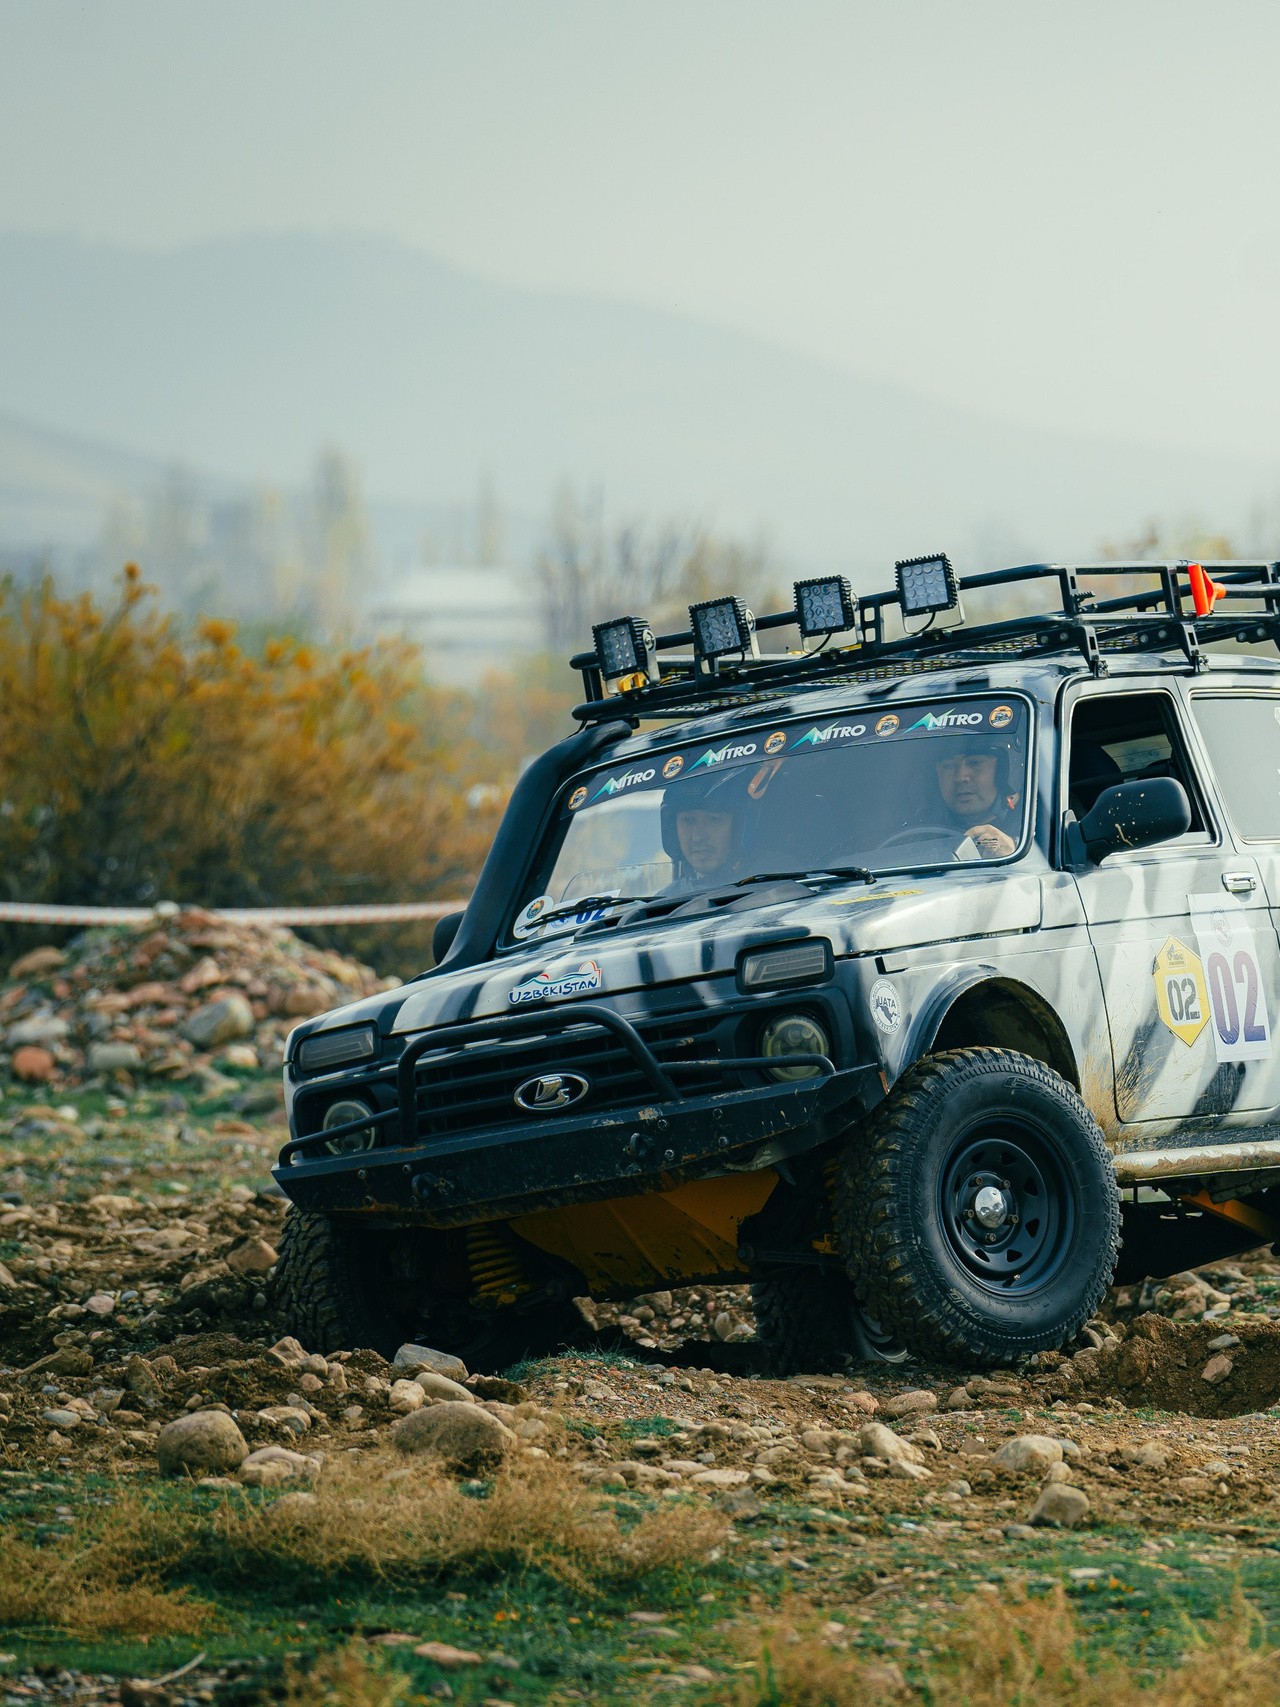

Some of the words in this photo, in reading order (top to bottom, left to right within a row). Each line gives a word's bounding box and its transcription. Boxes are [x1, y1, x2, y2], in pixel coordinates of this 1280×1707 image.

[928, 712, 984, 729] NITRO
[812, 724, 867, 742] NITRO
[708, 743, 757, 765] NITRO
[610, 768, 656, 792] NITRO
[876, 995, 897, 1009] UATA
[1167, 977, 1200, 1021] 02
[1208, 950, 1267, 1045] 02
